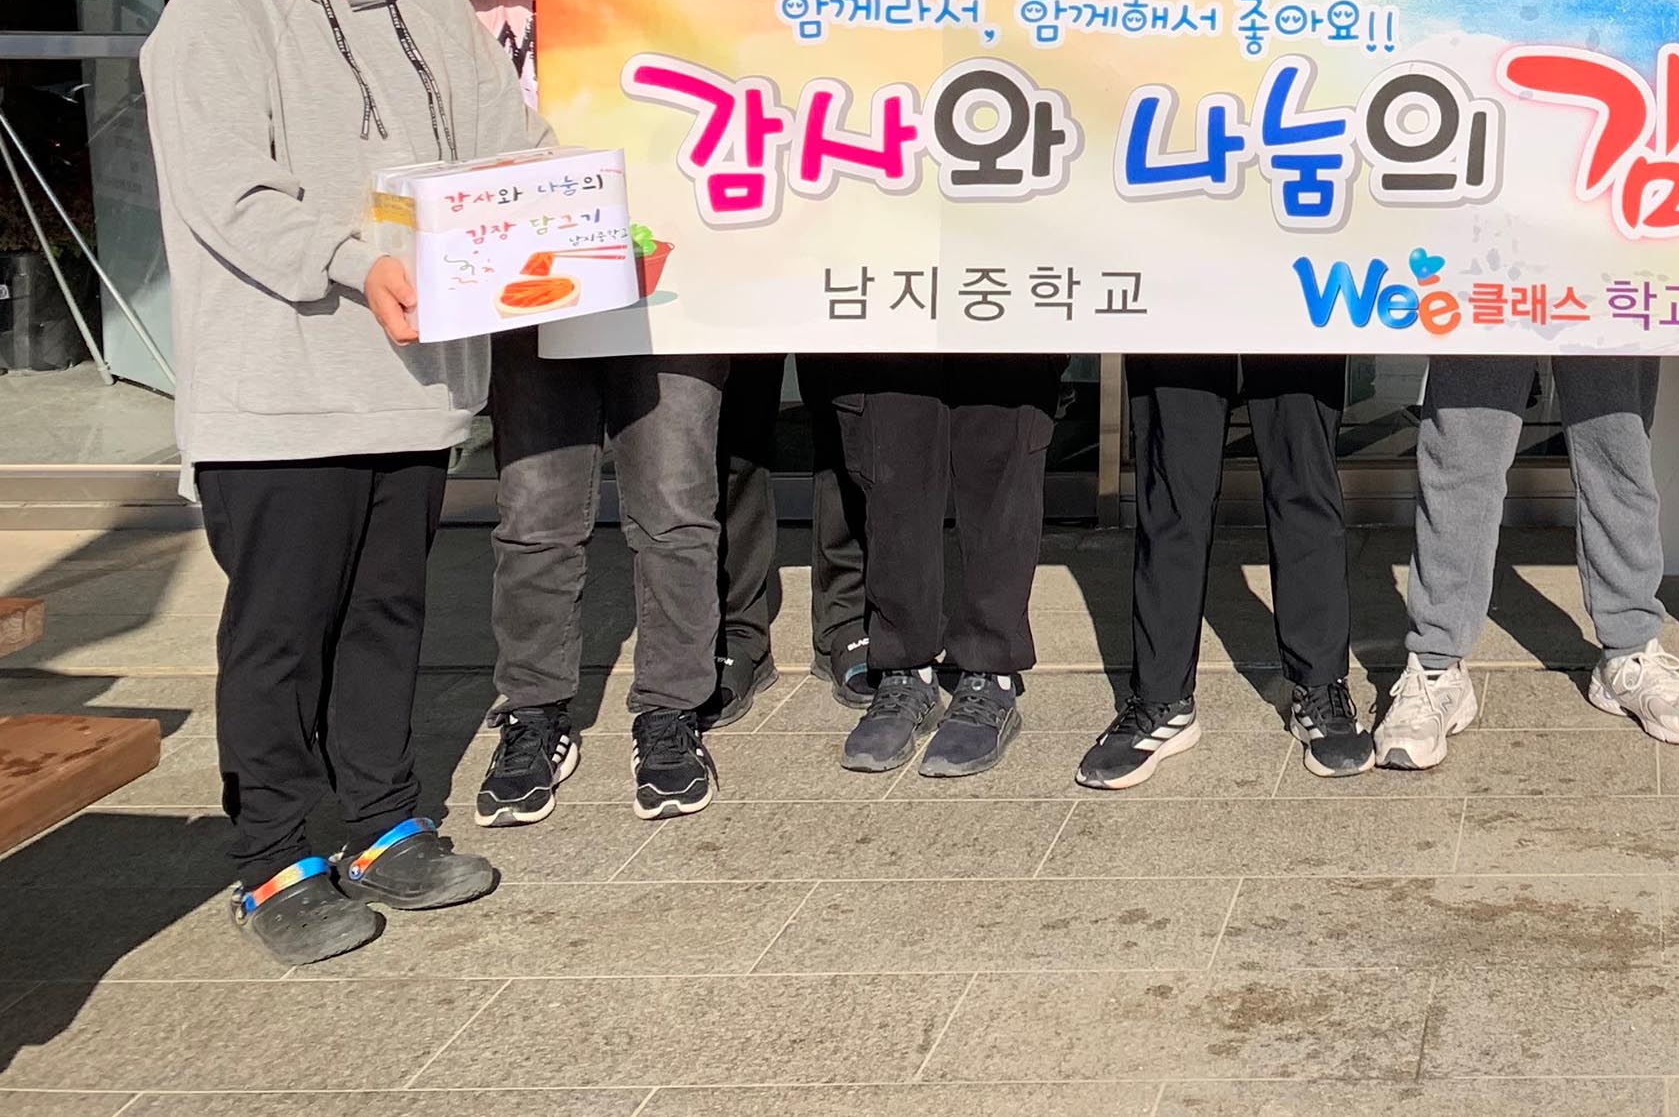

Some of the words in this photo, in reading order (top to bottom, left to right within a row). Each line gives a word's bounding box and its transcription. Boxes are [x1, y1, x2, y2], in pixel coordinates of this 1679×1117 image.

[631, 61, 1066, 214] 감사와
[1123, 63, 1489, 217] 나눔의
[444, 186, 524, 213] 감사와
[537, 173, 604, 197] 나눔의
[465, 221, 517, 246] 김장
[529, 208, 601, 236] 담그기
[822, 265, 1149, 321] 남지중학교
[1292, 255, 1461, 335] Wee
[1467, 282, 1591, 326] 클래스
